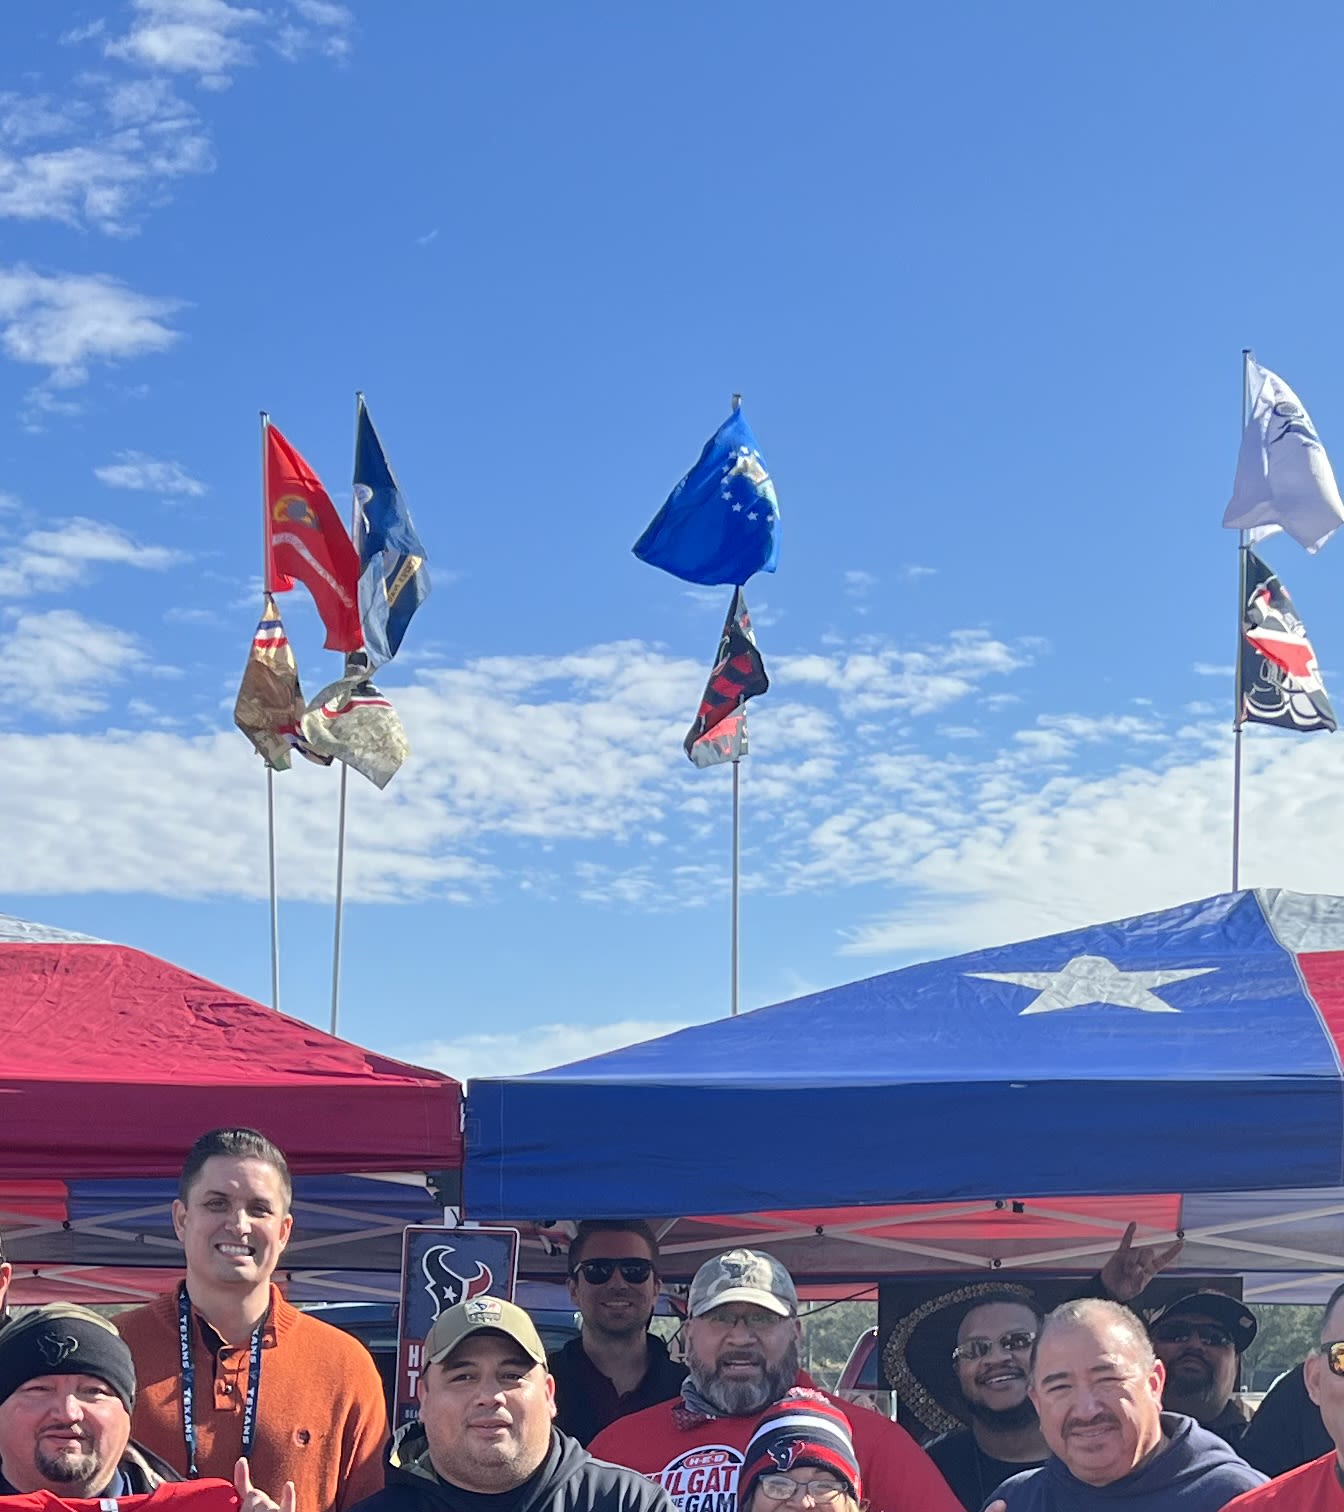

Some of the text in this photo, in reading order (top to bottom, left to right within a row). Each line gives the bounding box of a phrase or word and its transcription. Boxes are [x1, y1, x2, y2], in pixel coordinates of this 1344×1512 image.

[179, 1314, 191, 1369] TEXANS
[183, 1387, 194, 1443] TEXANS
[242, 1386, 256, 1444] TEXANS
